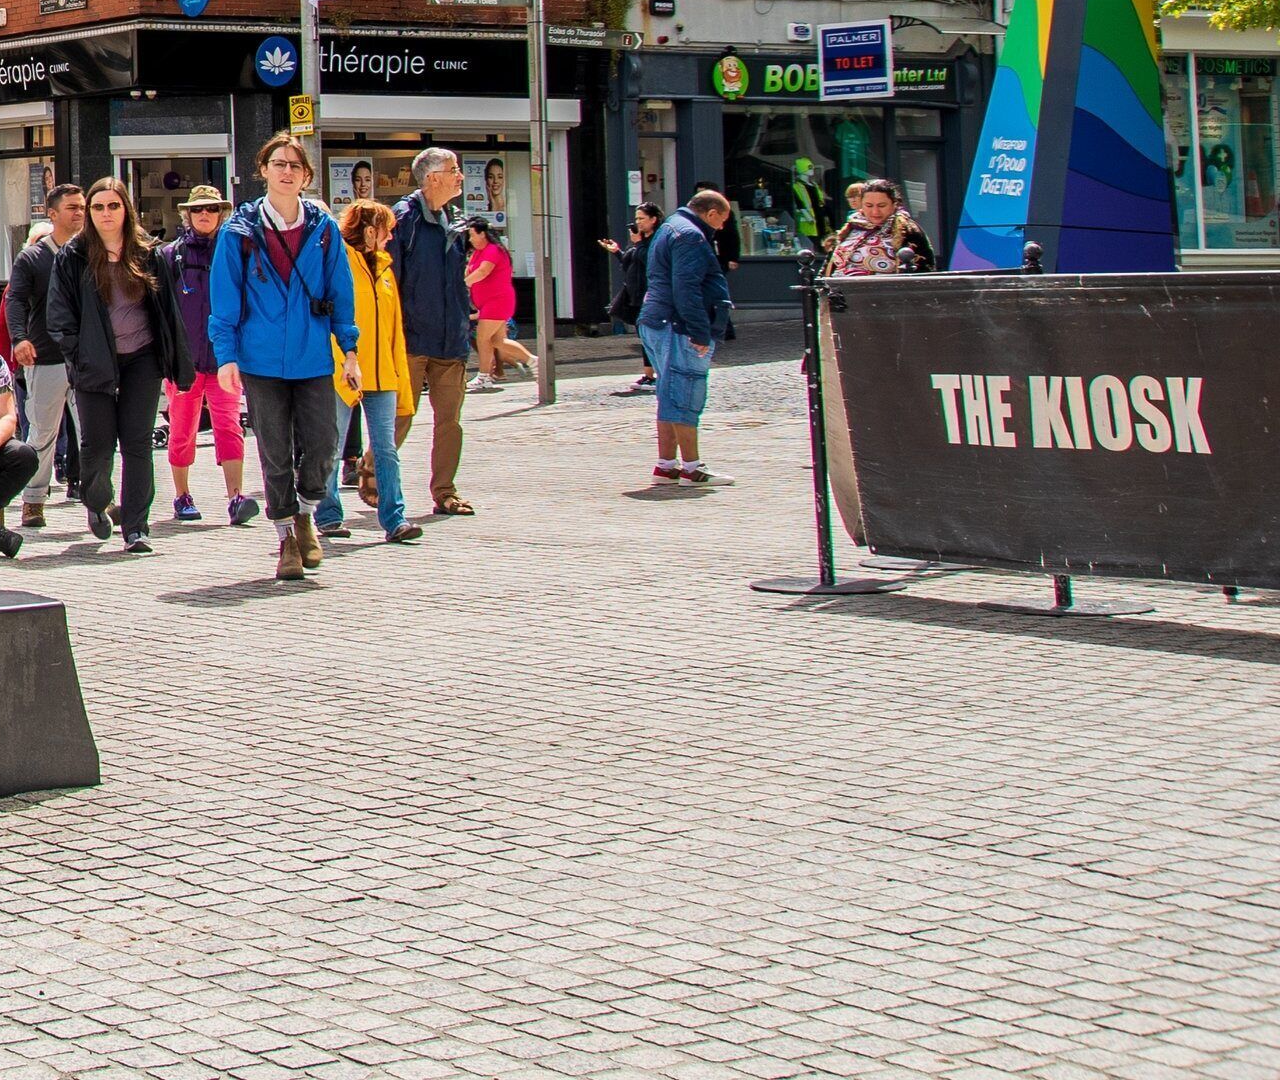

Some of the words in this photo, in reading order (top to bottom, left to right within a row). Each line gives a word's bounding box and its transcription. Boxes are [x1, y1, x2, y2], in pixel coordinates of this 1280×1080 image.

[548, 36, 569, 45] Tourist
[569, 37, 603, 47] Information
[829, 33, 877, 45] PALMER
[49, 62, 69, 74] CLINIC
[319, 41, 425, 82] thérapie
[434, 60, 468, 70] CLINIC
[835, 57, 849, 69] TO
[854, 56, 874, 69] LET
[1196, 57, 1271, 75] COSMETICS
[893, 69, 924, 82] nter
[927, 68, 947, 81] Ltd
[930, 374, 1017, 448] THE
[1027, 374, 1213, 455] KIOSK
